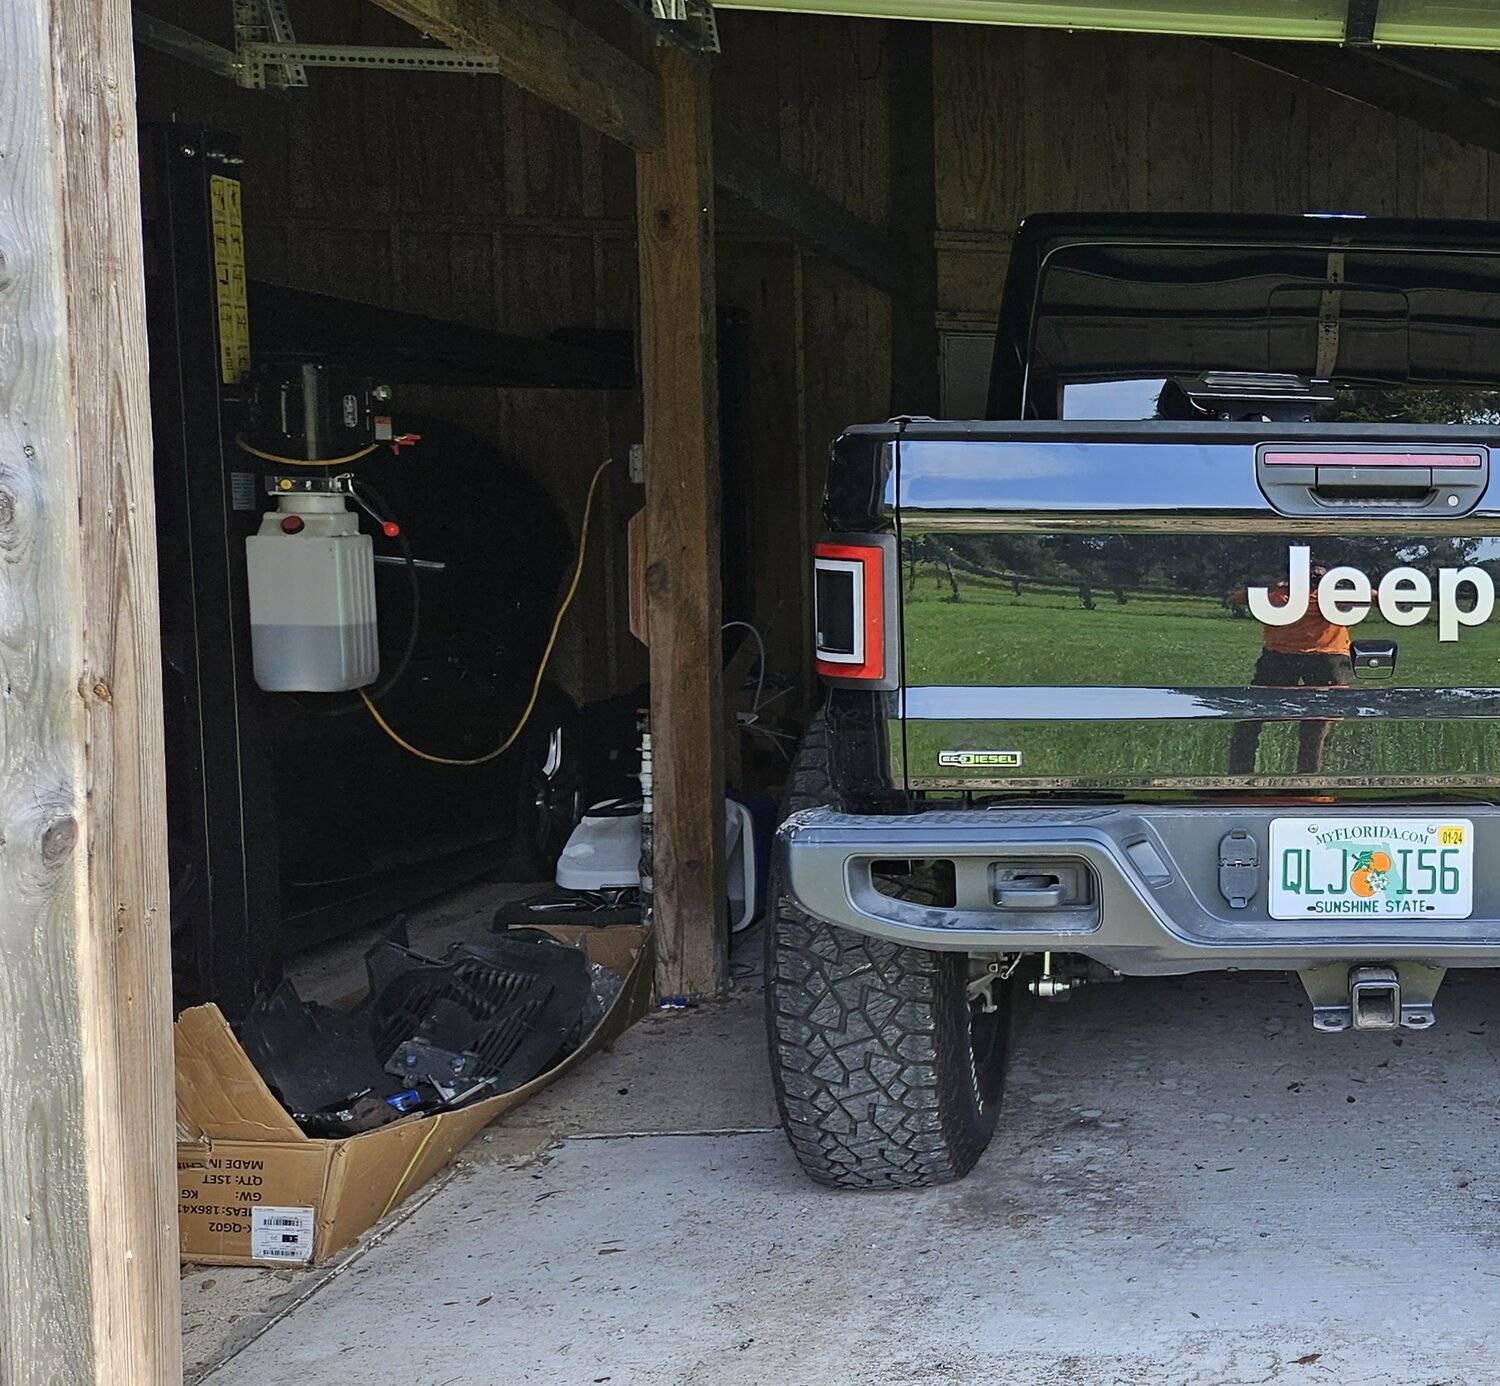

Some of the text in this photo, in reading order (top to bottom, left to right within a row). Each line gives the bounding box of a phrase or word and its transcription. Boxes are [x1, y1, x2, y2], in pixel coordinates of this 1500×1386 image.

[1247, 545, 1496, 642] Jeep
[1315, 825, 1429, 845] MYFLORIDA.COM
[1442, 831, 1463, 844] 01-24
[1282, 849, 1348, 895] QLJ
[1315, 900, 1426, 913] SUNSHINE STATE
[209, 1158, 222, 1169] IN
[226, 1159, 264, 1170] MADE
[202, 1174, 263, 1186] QTY: 1SET
[181, 1189, 262, 1202] GW: KG
[222, 1206, 252, 1217] EAS:
